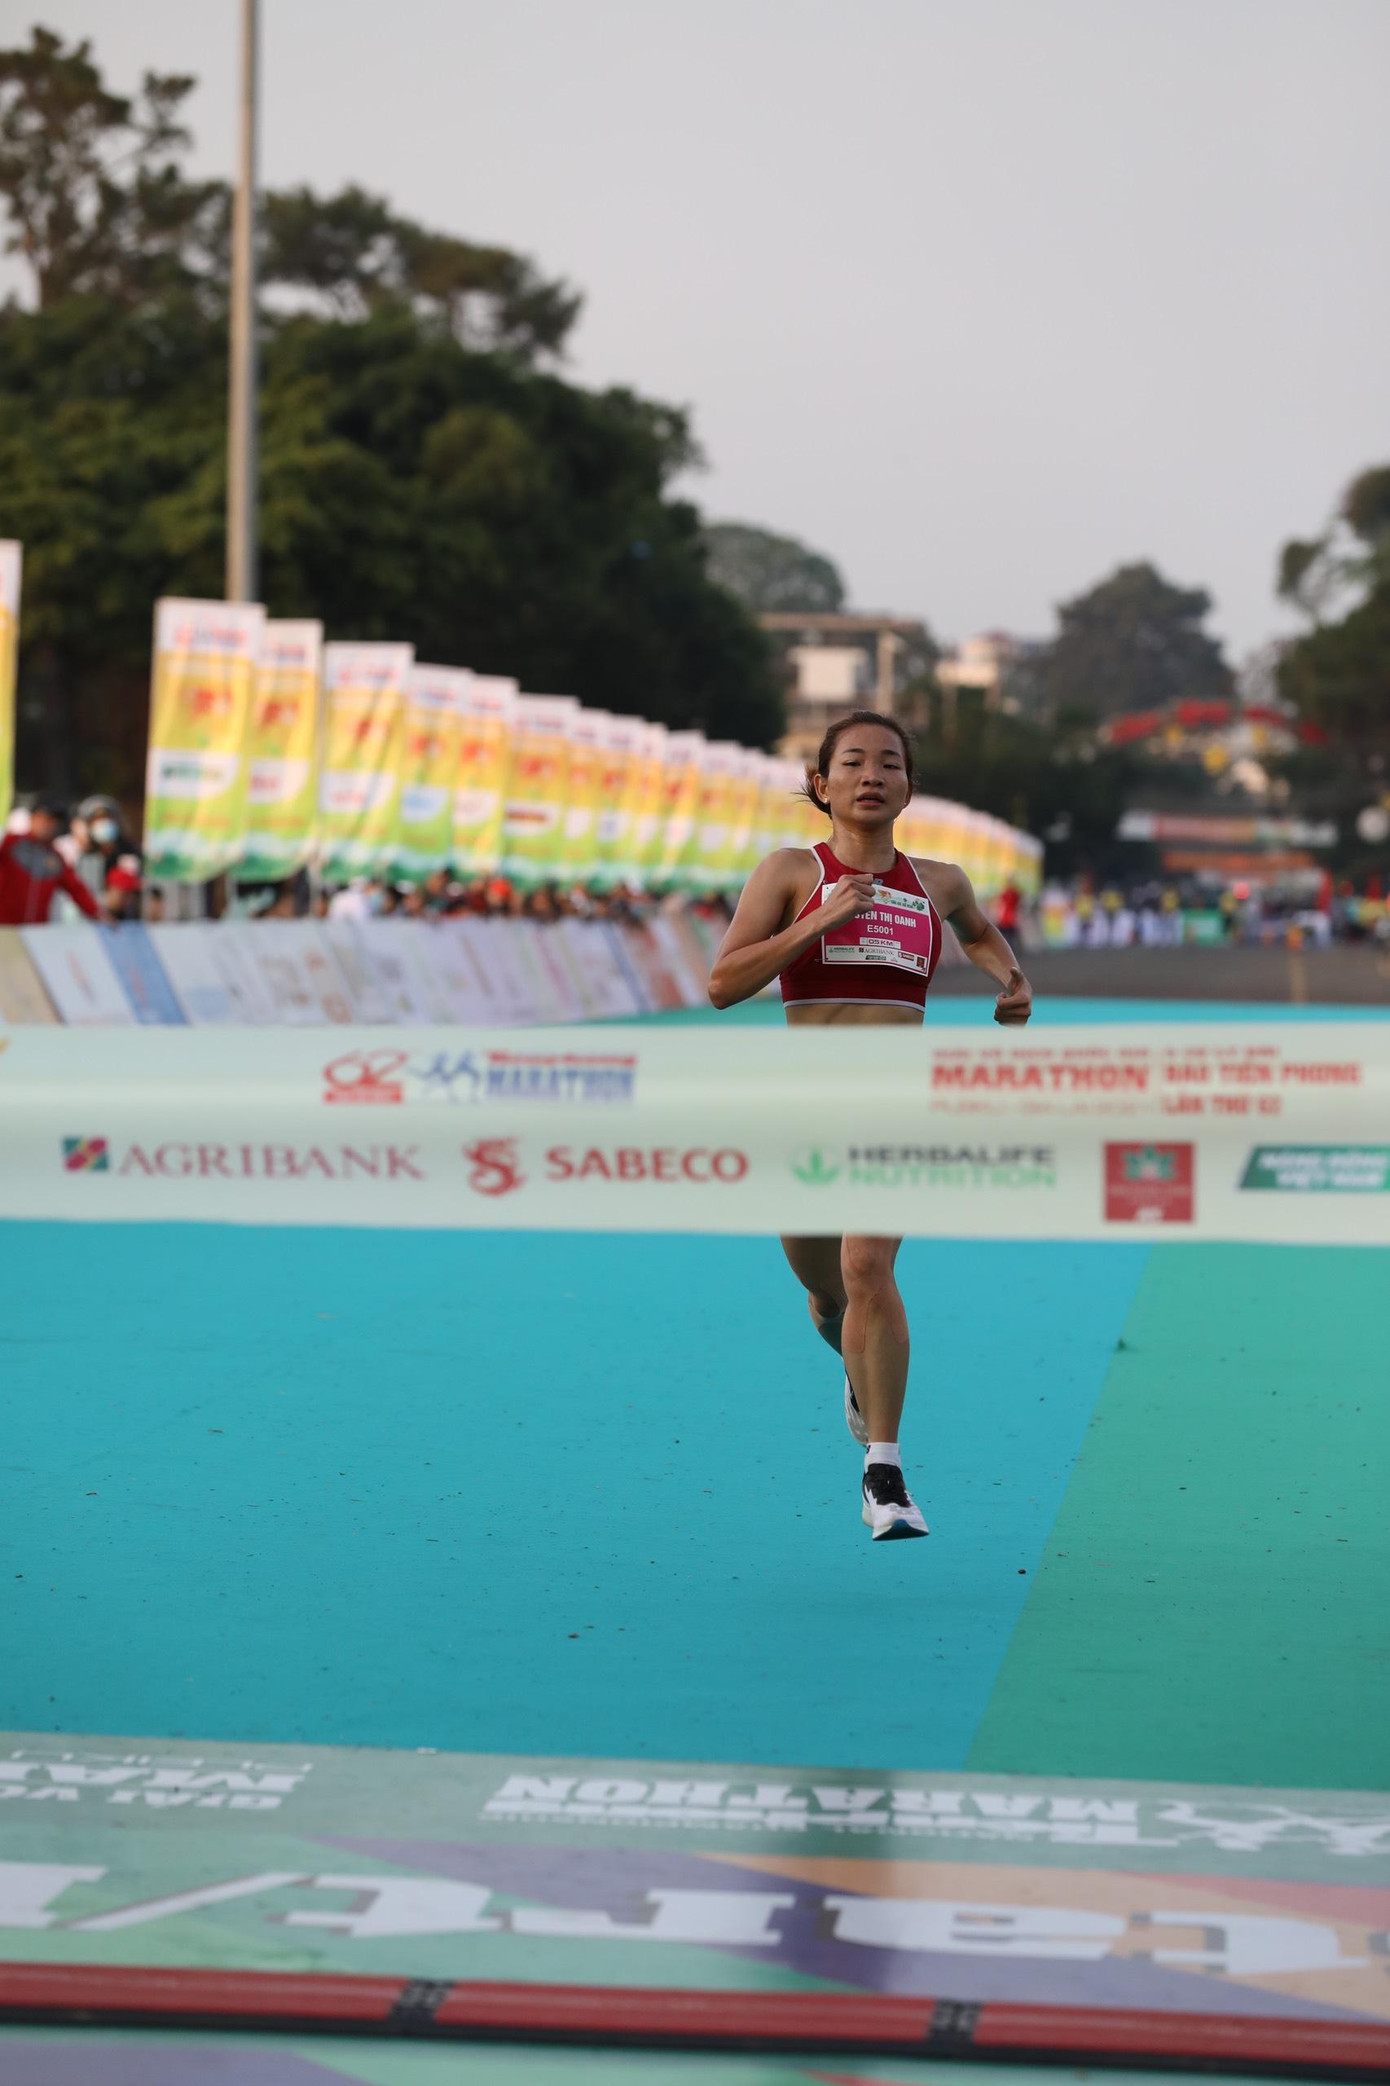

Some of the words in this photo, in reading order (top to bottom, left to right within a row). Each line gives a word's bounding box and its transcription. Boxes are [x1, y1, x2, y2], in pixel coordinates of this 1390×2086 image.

[867, 925, 894, 935] E5001
[880, 911, 893, 924] THỊ
[895, 914, 916, 928] OANH
[486, 1066, 637, 1100] MARATHON
[931, 1064, 1147, 1092] MARATHON
[1281, 1062, 1361, 1085] PHONG
[118, 1143, 425, 1181] AGRIBANK
[546, 1146, 748, 1183] SABECO
[848, 1145, 1056, 1166] HERBALIFE
[849, 1165, 1057, 1189] NUTRITION
[492, 1775, 1138, 1822] MARATHON
